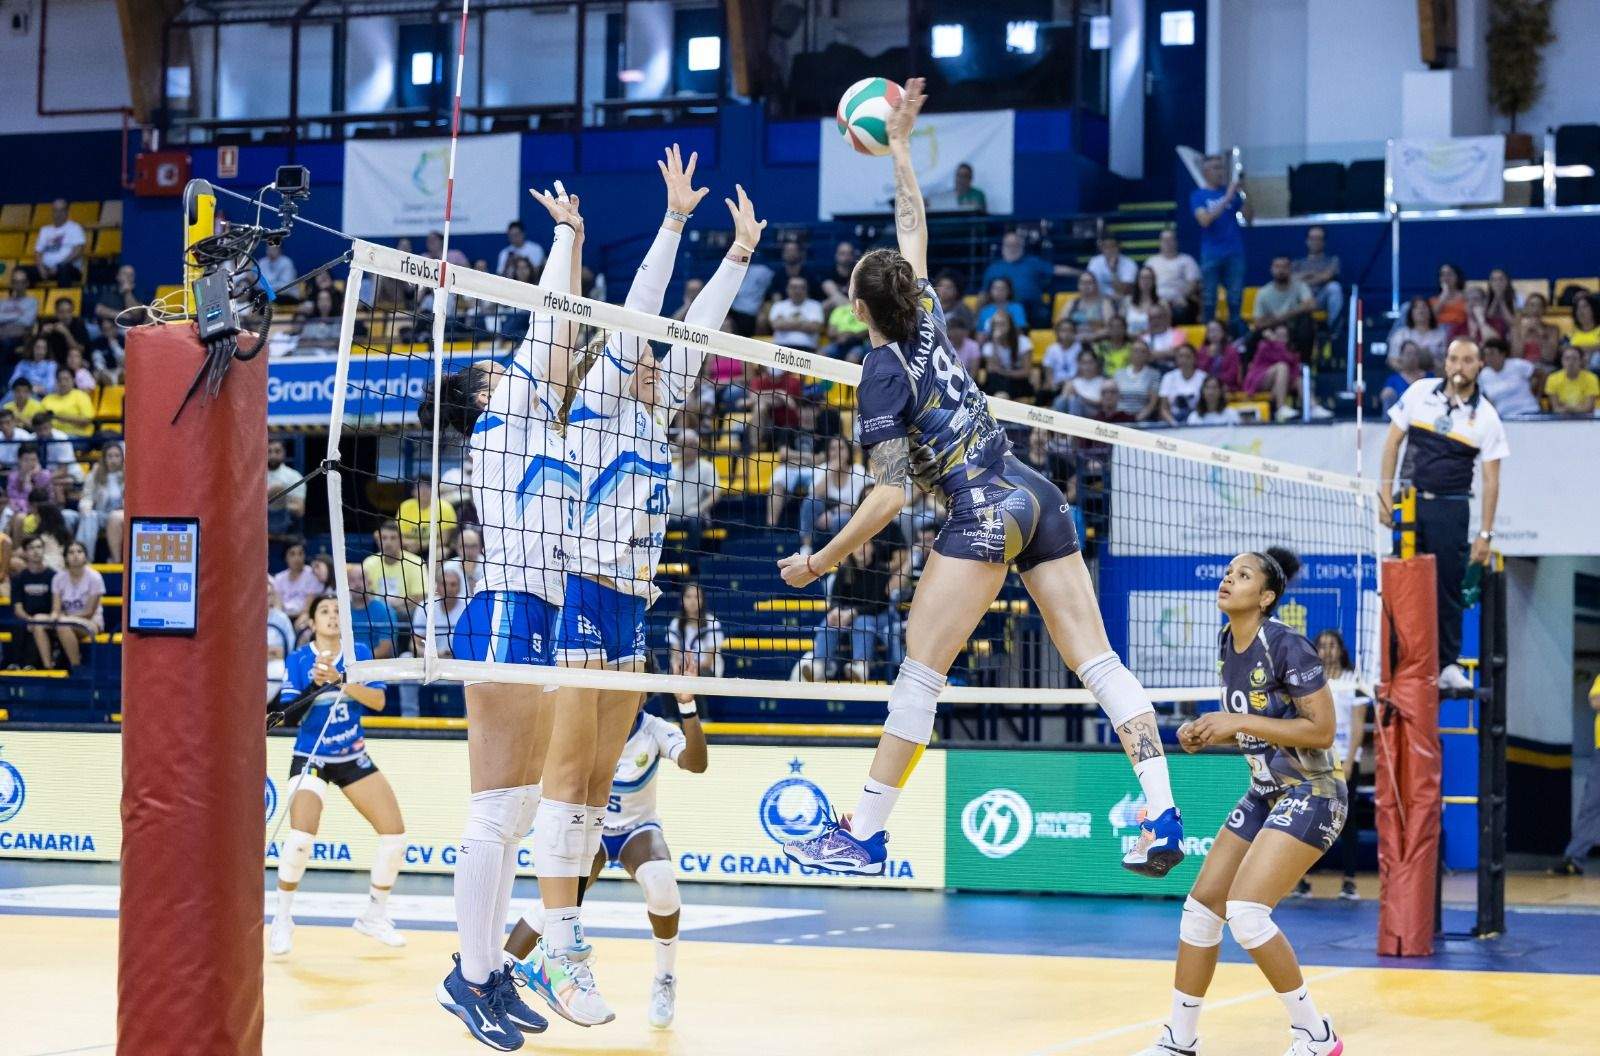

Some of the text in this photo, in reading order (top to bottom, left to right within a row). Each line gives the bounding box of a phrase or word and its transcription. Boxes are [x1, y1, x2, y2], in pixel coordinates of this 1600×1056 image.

[543, 291, 592, 318] rfevb.com
[667, 322, 709, 346] rfevb.com
[774, 348, 812, 370] rfevb.com
[932, 345, 965, 402] 8
[0, 832, 95, 852] CANARIA
[405, 846, 433, 864] CV
[680, 854, 710, 873] CV
[720, 855, 790, 875] GRAN
